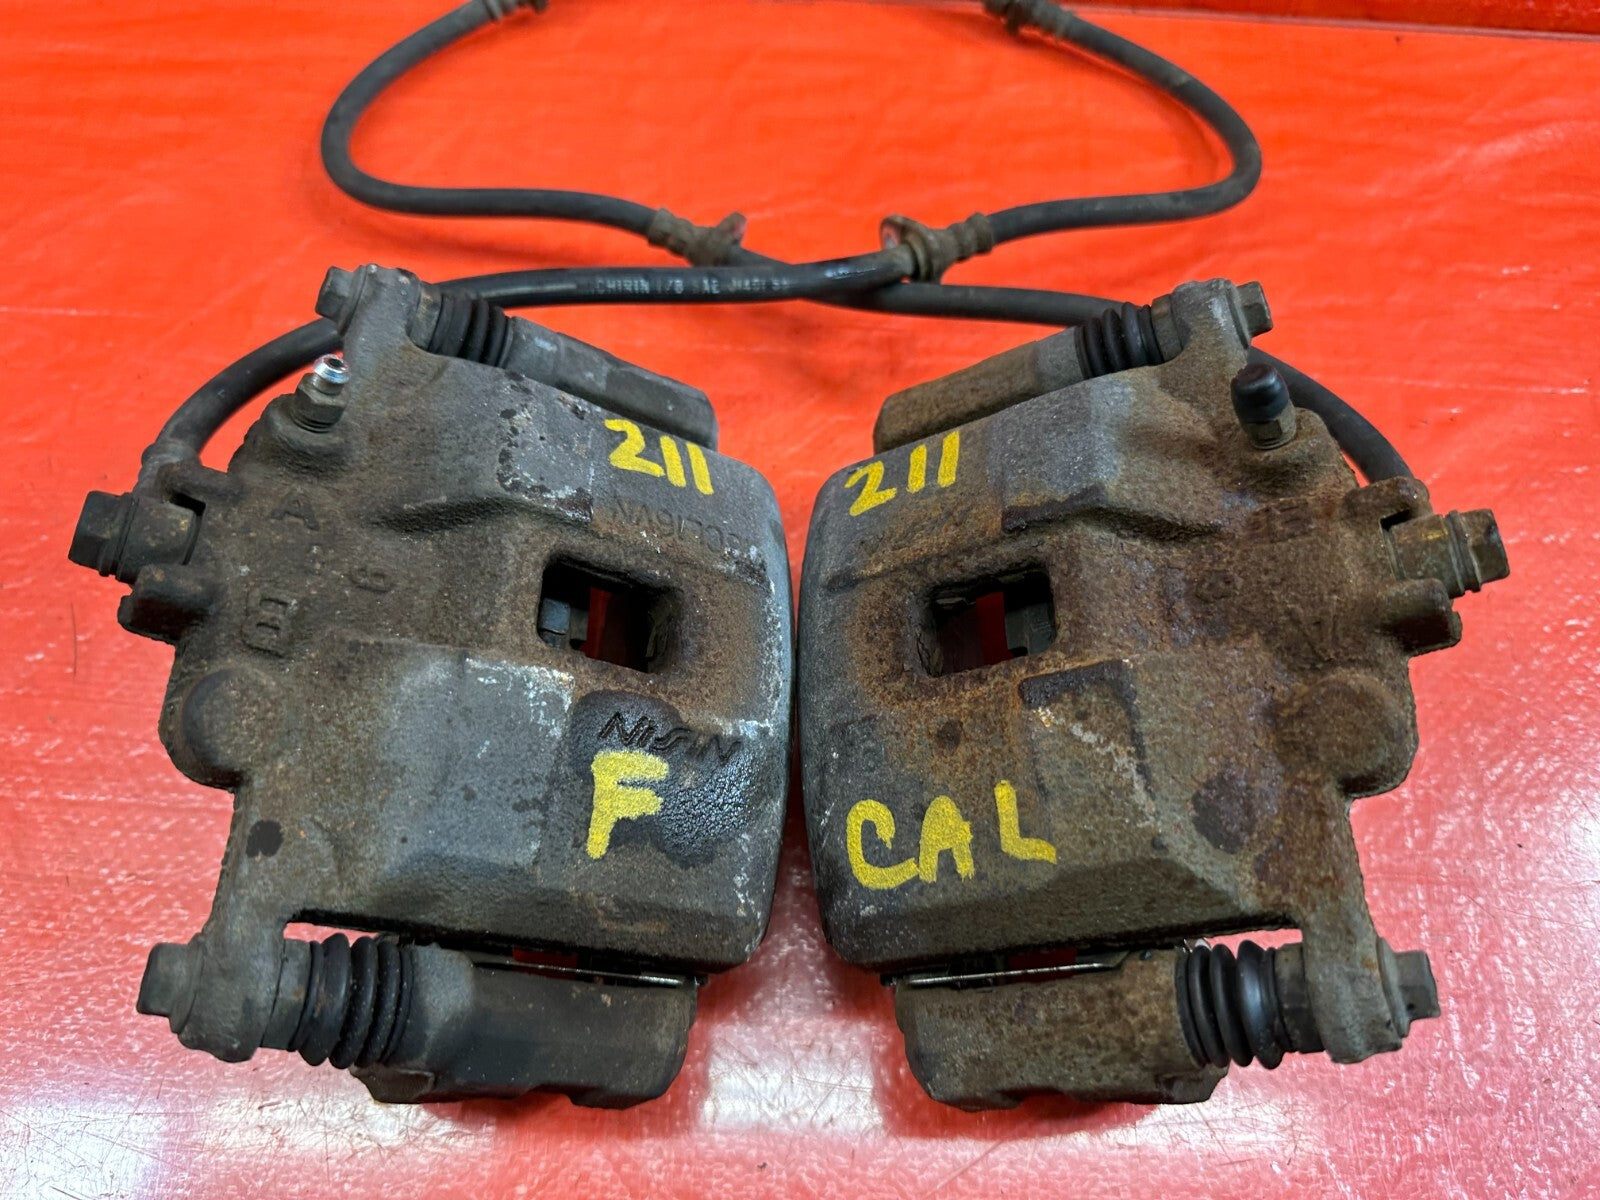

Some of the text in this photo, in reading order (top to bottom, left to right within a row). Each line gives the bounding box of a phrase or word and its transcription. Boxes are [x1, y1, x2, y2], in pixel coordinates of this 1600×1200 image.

[604, 418, 715, 495] 211
[844, 430, 960, 517] 211
[586, 749, 669, 859] F
[846, 779, 1058, 889] CAL
